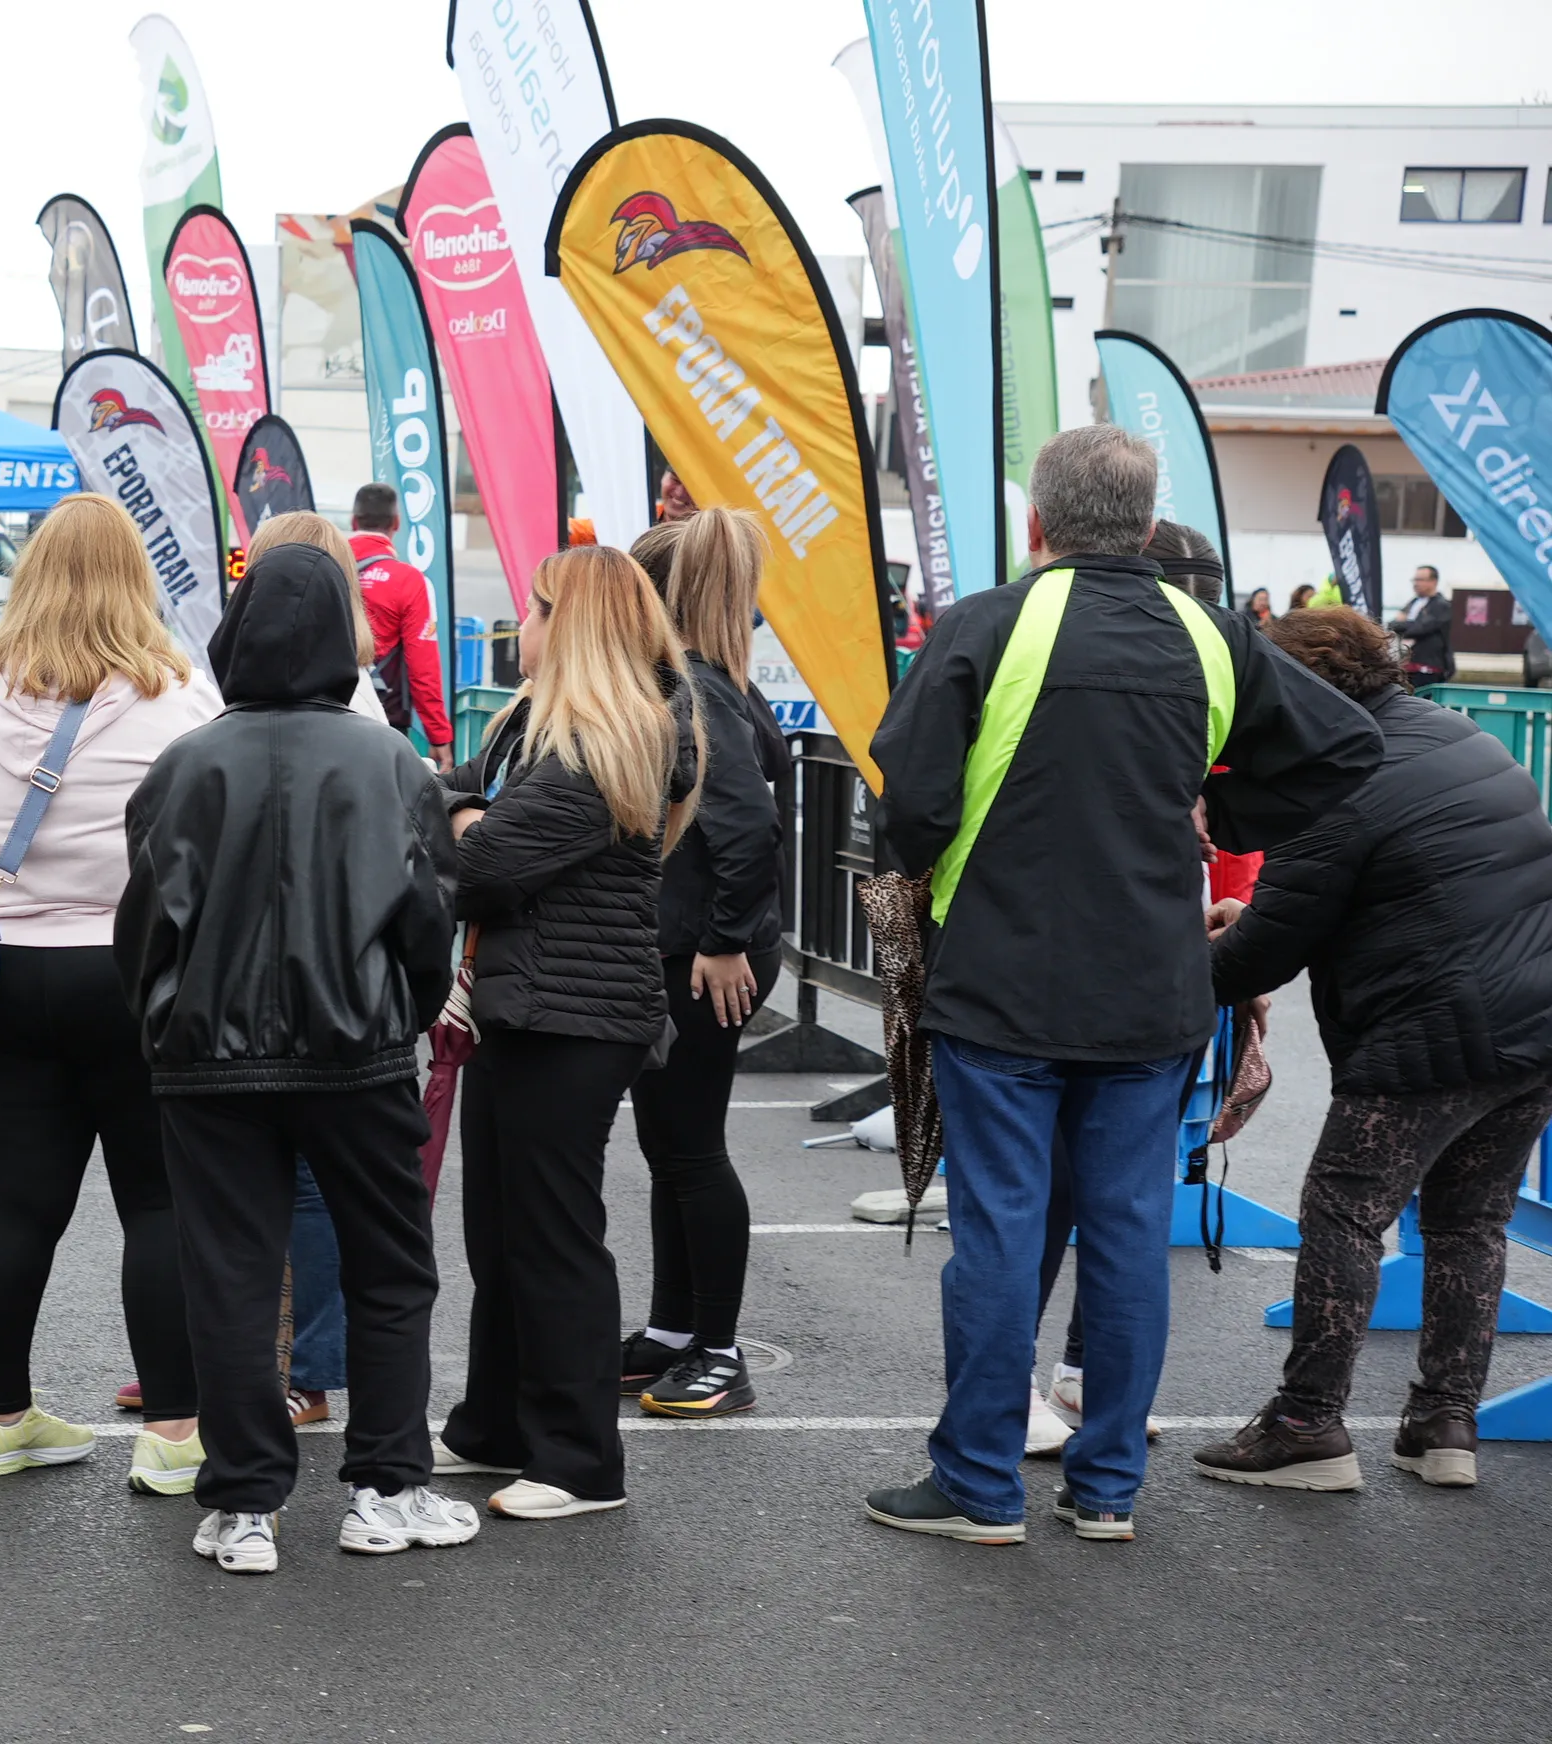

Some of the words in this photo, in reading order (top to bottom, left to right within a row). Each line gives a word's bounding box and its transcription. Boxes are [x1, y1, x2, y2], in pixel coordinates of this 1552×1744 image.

[102, 443, 163, 532] EPORA
[146, 525, 200, 607] TRAIL
[642, 284, 762, 443] EPORA
[733, 416, 839, 560] TRAIL
